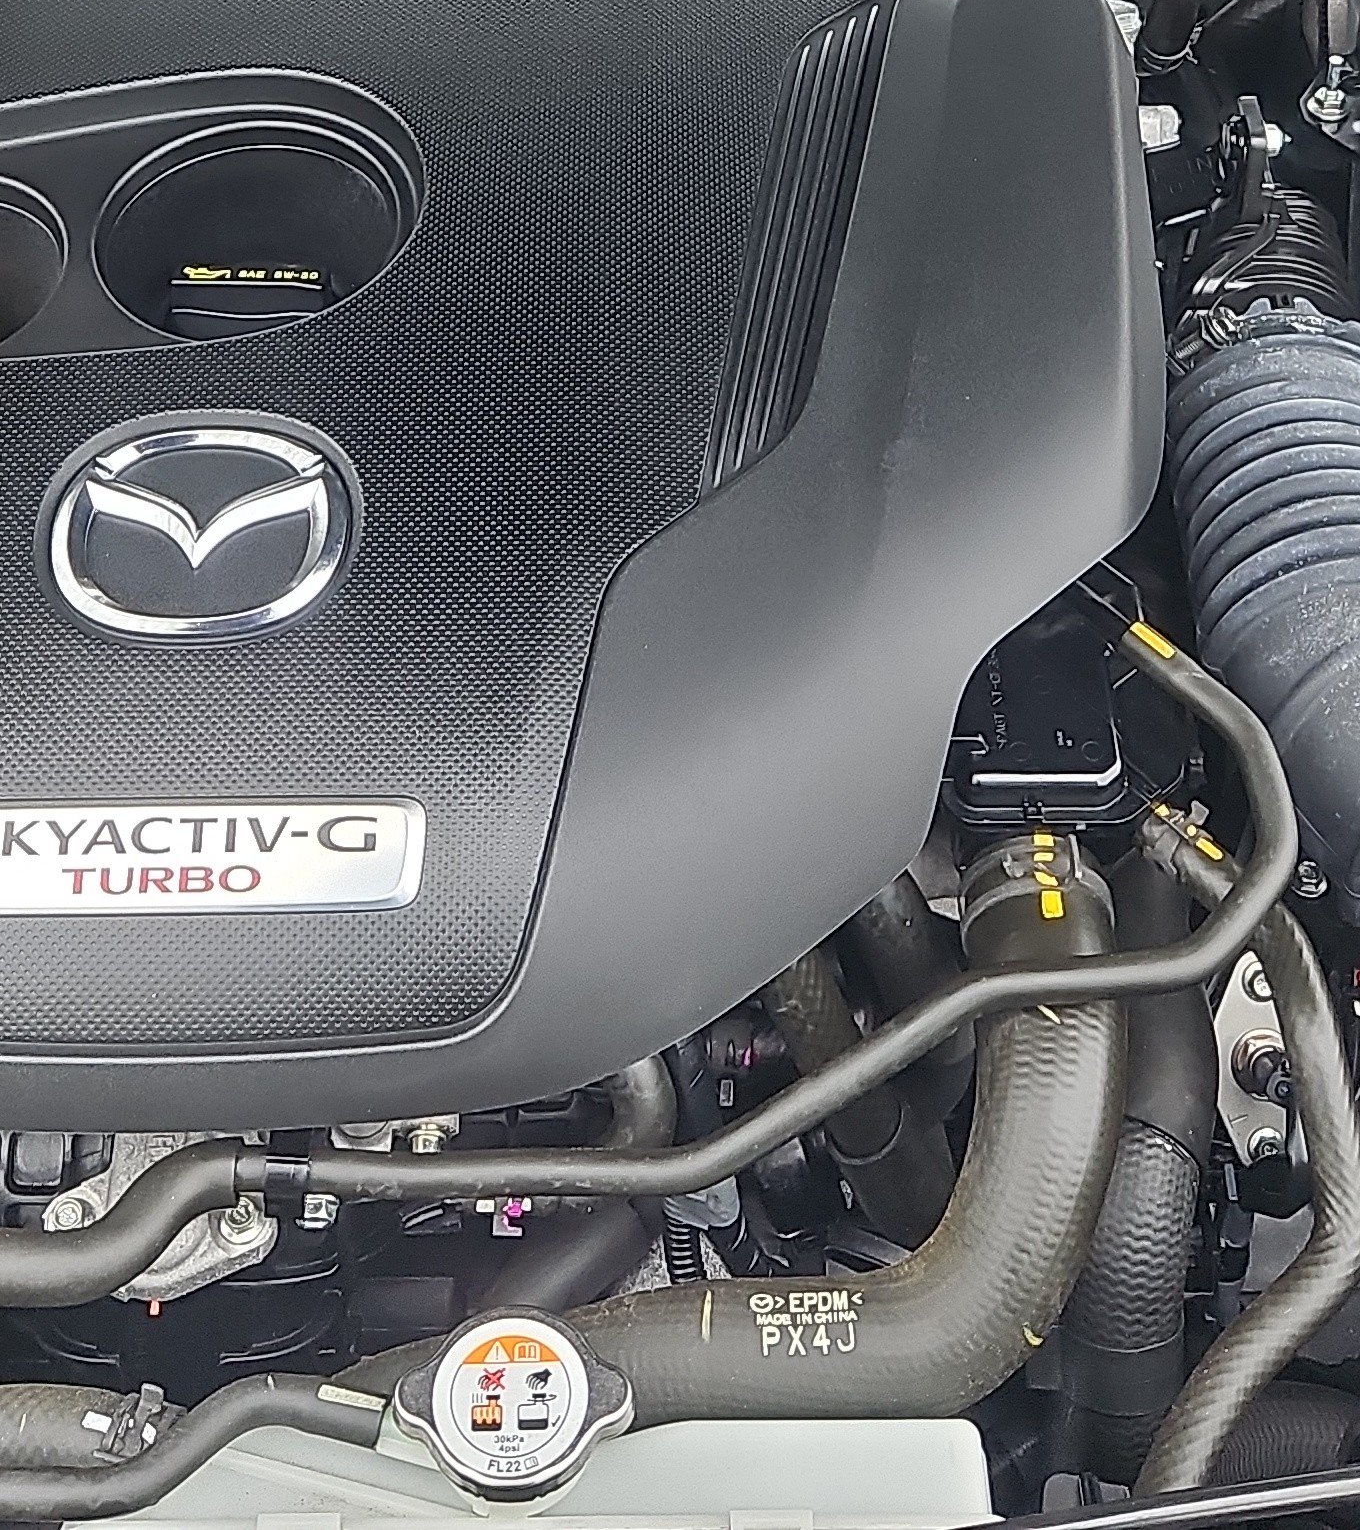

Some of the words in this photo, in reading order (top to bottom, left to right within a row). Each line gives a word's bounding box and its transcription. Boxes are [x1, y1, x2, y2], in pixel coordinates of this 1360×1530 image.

[61, 865, 262, 895] TURBO
[756, 1313, 792, 1325] MADE
[796, 1312, 813, 1325] IN
[814, 1310, 858, 1324] CHINA
[762, 1322, 856, 1356] PX4J
[493, 1434, 525, 1444] 30kPa
[498, 1443, 520, 1453] 4psi
[487, 1459, 522, 1473] FL22
